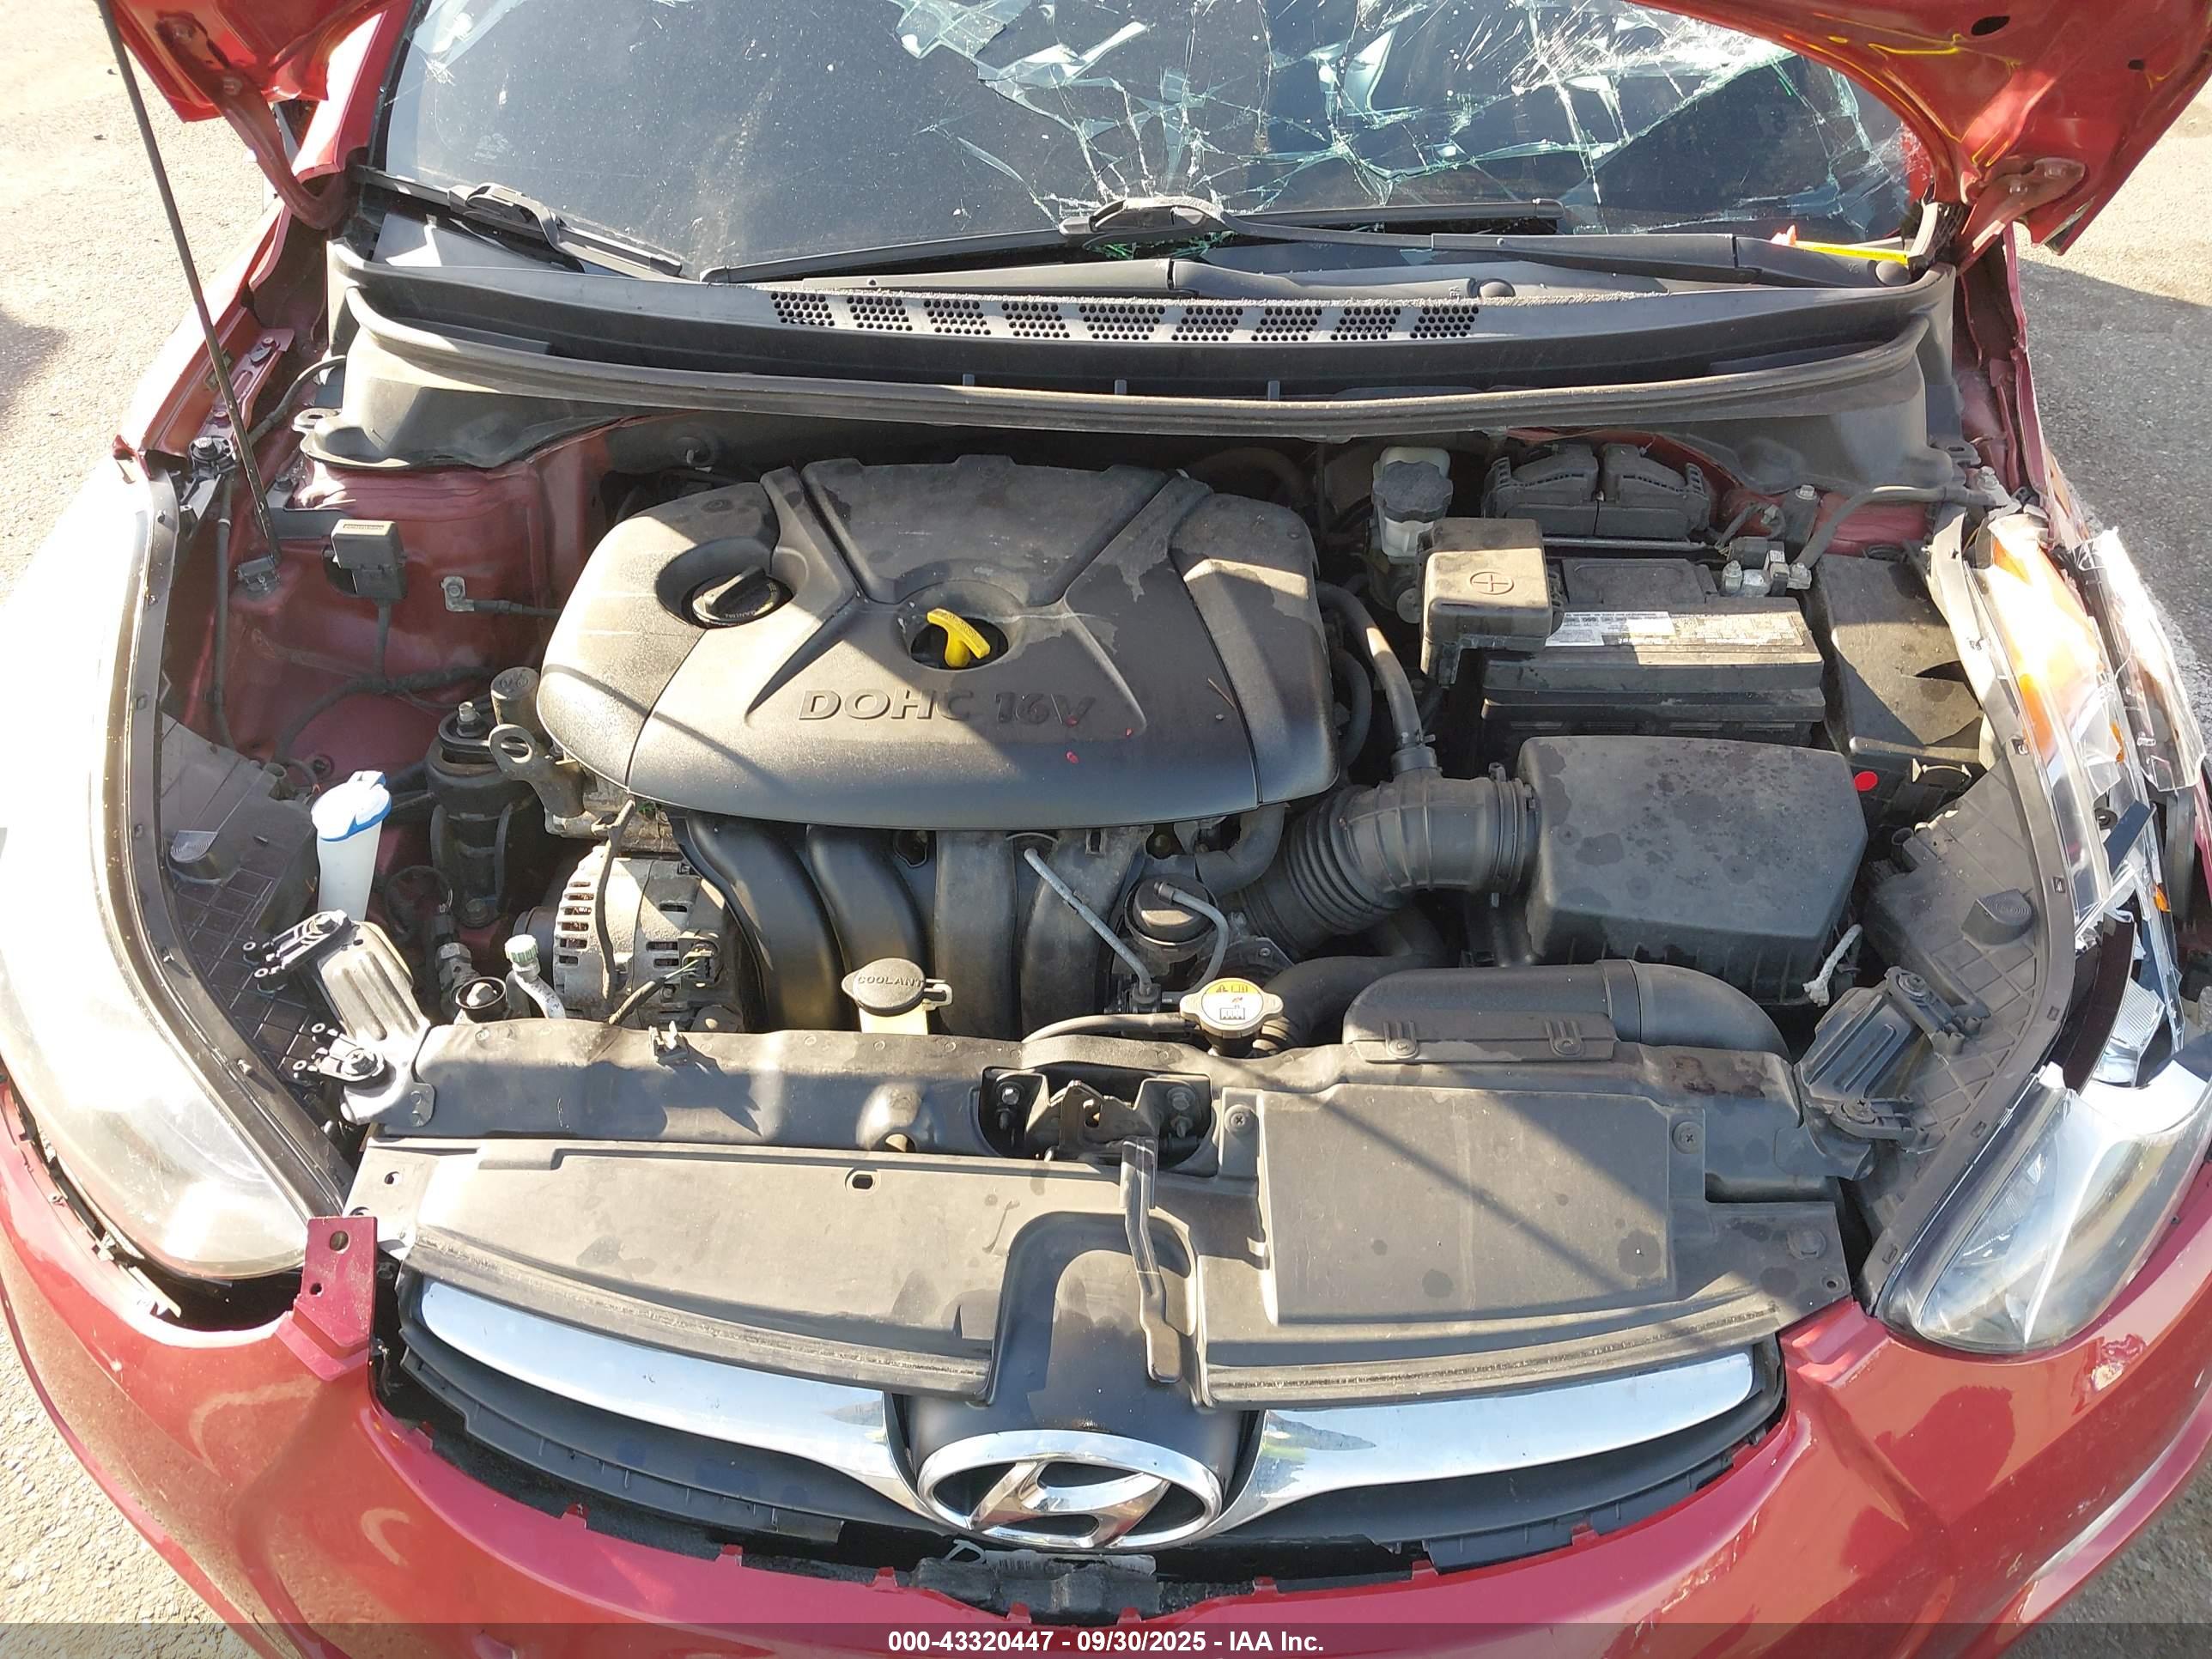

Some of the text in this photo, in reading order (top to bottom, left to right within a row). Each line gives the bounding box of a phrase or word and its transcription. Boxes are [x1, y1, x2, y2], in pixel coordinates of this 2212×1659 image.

[798, 688, 1097, 726] DOHC 16V
[857, 975, 925, 988] COOLANT
